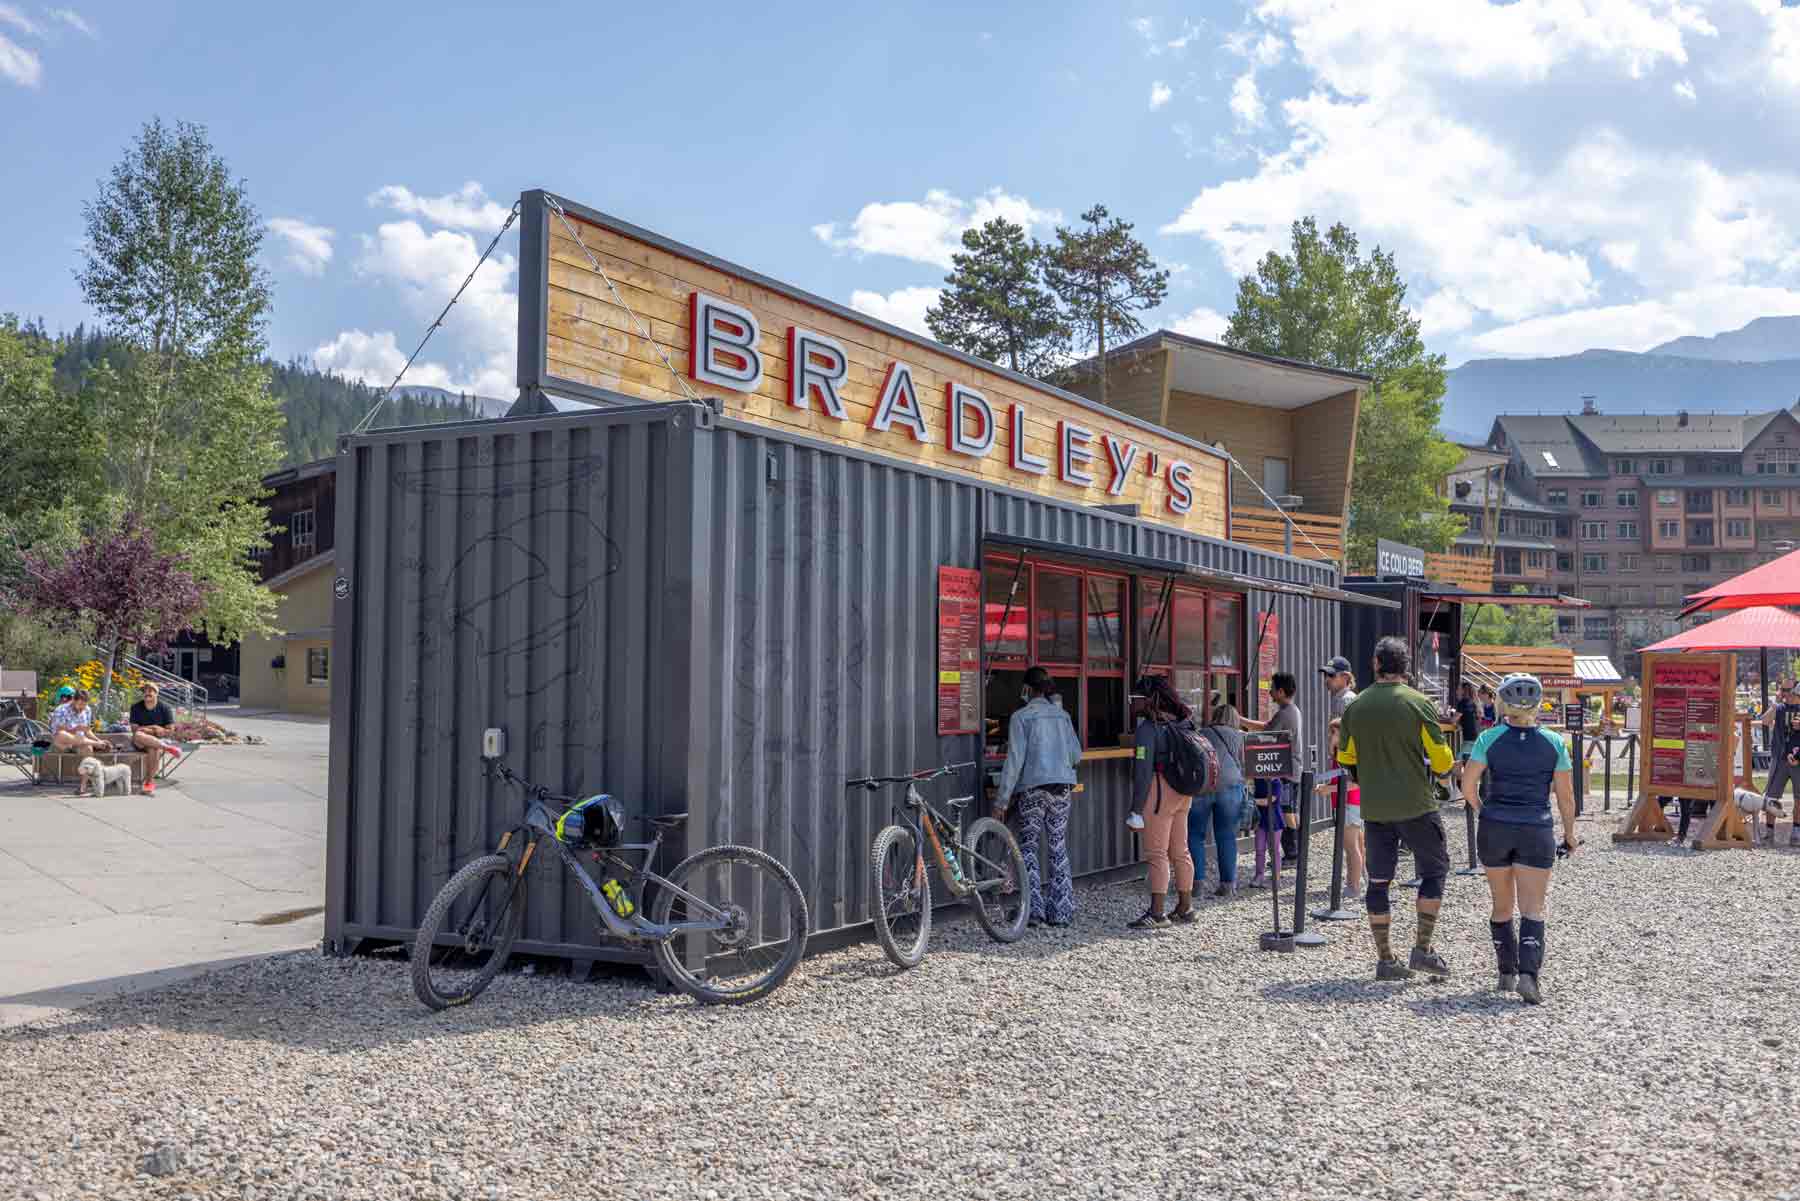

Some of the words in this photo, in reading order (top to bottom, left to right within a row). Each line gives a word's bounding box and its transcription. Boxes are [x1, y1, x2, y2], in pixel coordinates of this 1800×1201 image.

[688, 291, 1195, 515] BRADLEY'S
[1379, 550, 1390, 572] ICE
[1390, 553, 1408, 575] COLD
[1408, 557, 1424, 576] BEER
[1257, 752, 1280, 761] EXIT
[1255, 764, 1283, 773] ONLY
